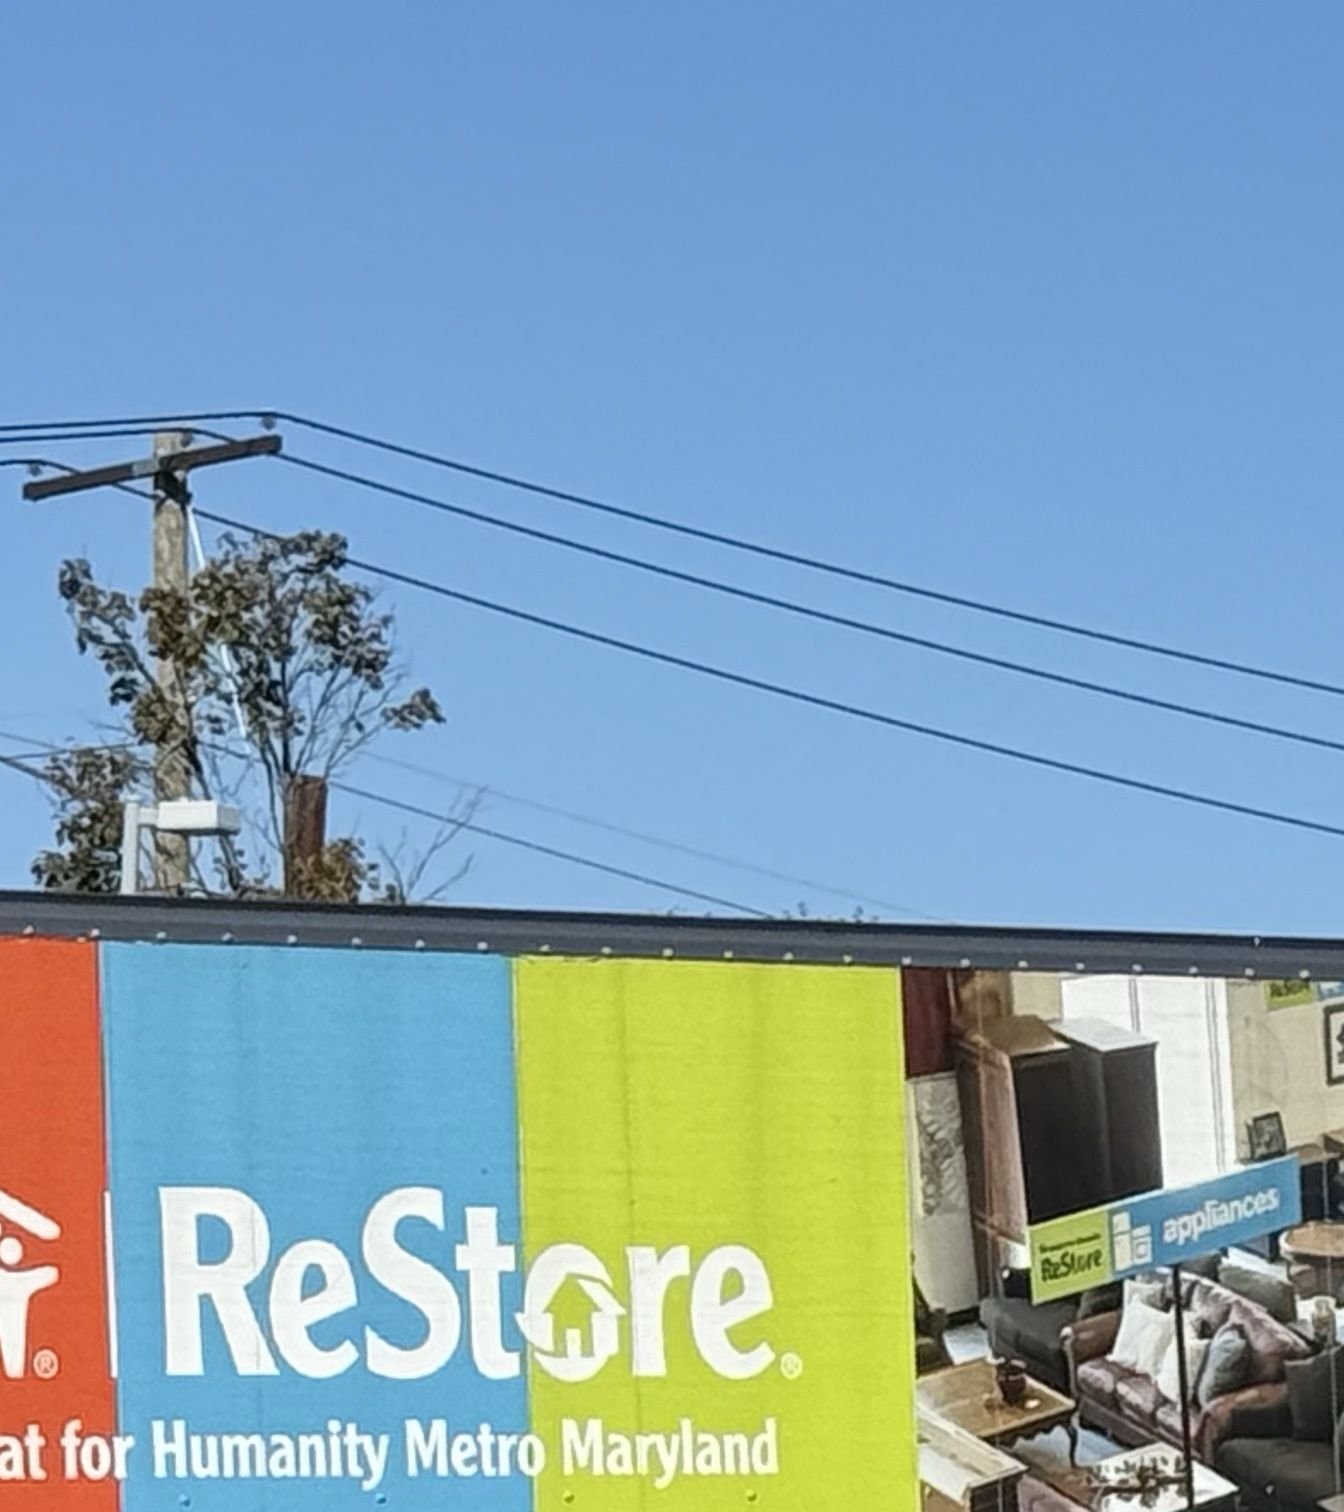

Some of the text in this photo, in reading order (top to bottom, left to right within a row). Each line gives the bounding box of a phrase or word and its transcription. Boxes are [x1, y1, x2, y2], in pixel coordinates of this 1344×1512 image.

[1162, 1187, 1281, 1246] appliances
[158, 1186, 778, 1379] ReStore
[61, 1416, 133, 1480] for
[151, 1418, 389, 1490] Humanity
[405, 1417, 545, 1478] Metro
[560, 1416, 779, 1490] Maryland
